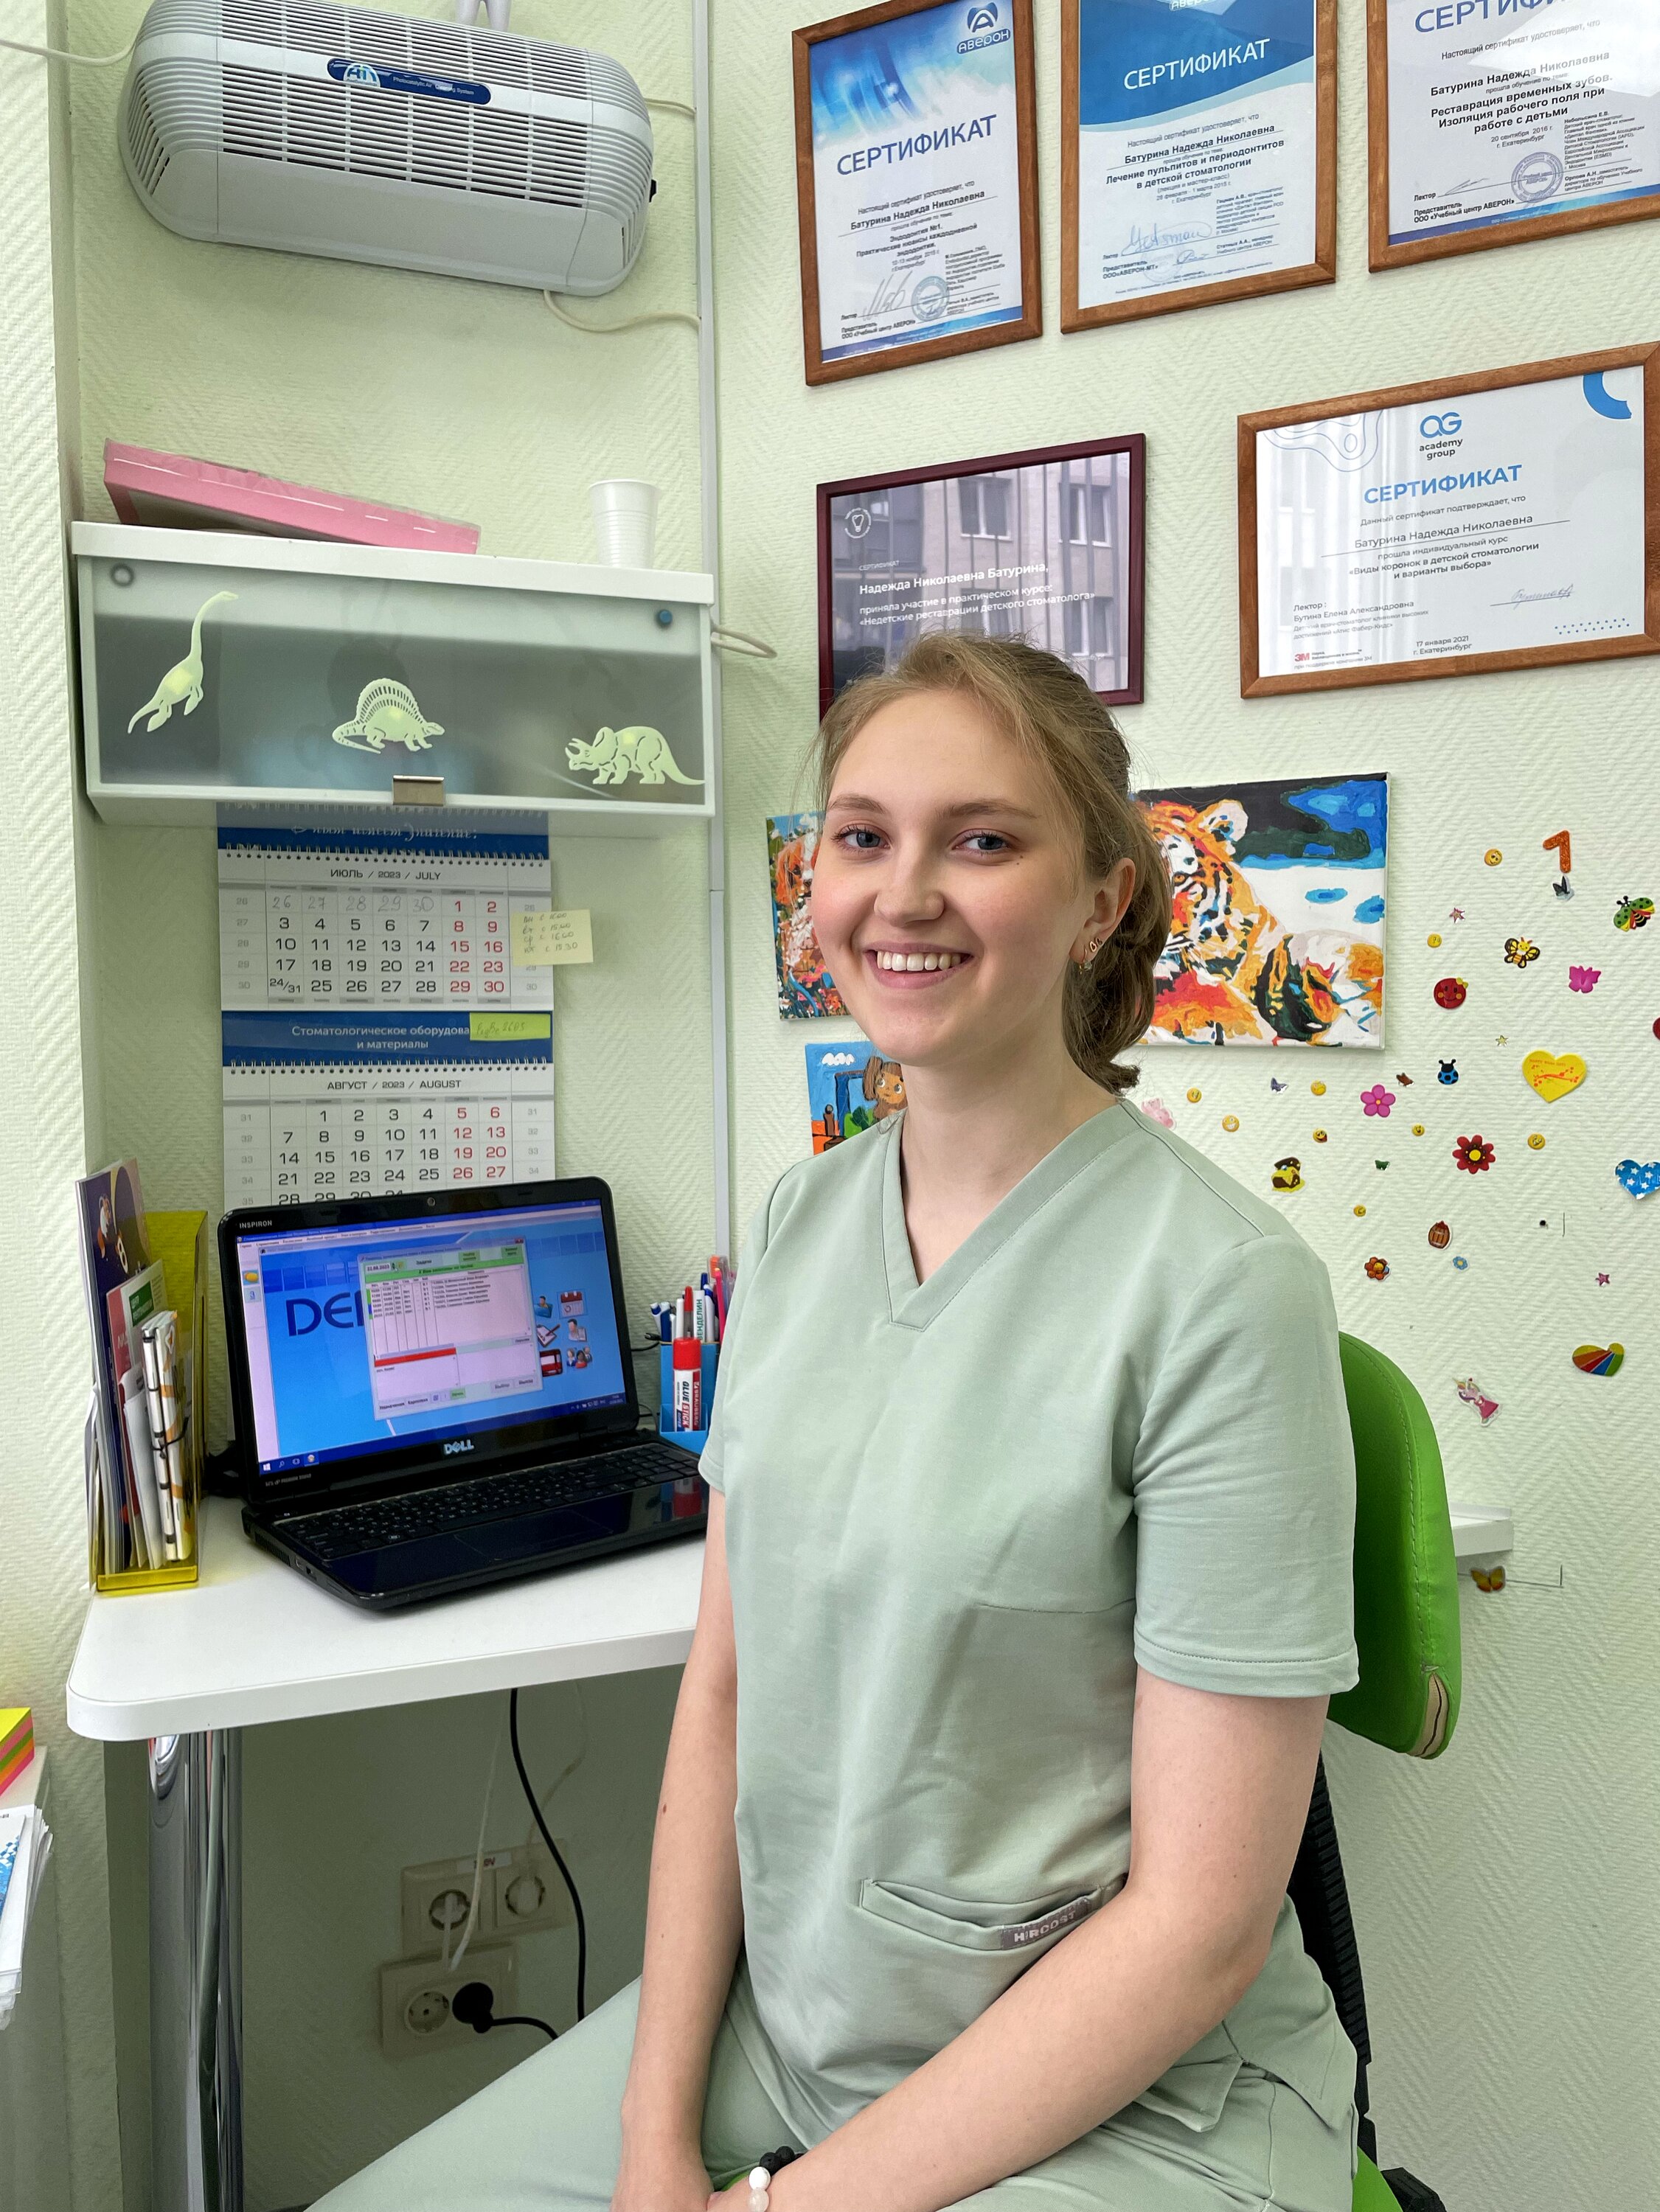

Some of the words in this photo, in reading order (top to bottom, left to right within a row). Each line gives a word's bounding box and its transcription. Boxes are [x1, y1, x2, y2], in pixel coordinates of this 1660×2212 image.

[1415, 0, 1557, 32] СЕРТИФ
[1442, 44, 1483, 60] Настоящий
[1484, 35, 1529, 51] сертификат
[1123, 38, 1271, 91] СЕРТИФИКАТ
[1431, 78, 1483, 96] Батурина
[1487, 67, 1537, 85] Надежда
[1540, 52, 1610, 73] Николаевна
[1431, 97, 1503, 117] Реставрация
[1506, 82, 1572, 102] временных
[1574, 73, 1613, 91] зубов.
[1439, 111, 1493, 128] Изоляция
[1496, 98, 1548, 118] рабочего
[1551, 92, 1579, 105] поля
[1583, 88, 1605, 102] при
[1474, 117, 1513, 134] работе
[1525, 107, 1569, 124] детьми
[837, 114, 997, 175] СЕРТИФИКАТ
[1125, 148, 1170, 164] Батурина
[1172, 139, 1214, 154] Надежда
[1216, 125, 1275, 145] Николаевна
[1106, 170, 1145, 184] Лечение
[1147, 159, 1198, 176] пульпитов
[1209, 140, 1285, 163] периодонтитов
[1145, 173, 1182, 189] детской
[1185, 159, 1251, 178] стоматологии
[1414, 192, 1436, 201] Лектор
[851, 215, 891, 230] Батурина
[894, 204, 930, 220] Надежда
[932, 191, 984, 209] Николаевна
[1414, 201, 1462, 216] Представитель
[1414, 215, 1428, 223] ООО
[1463, 205, 1482, 215] центр
[1419, 438, 1463, 451] academy
[1426, 448, 1456, 460] group
[1364, 464, 1522, 504] СЕРТИФИКАТ
[1395, 508, 1445, 521] сертификат
[1446, 498, 1510, 512] подтверждает,
[1511, 495, 1526, 503] что
[1355, 534, 1406, 549] Батурина
[1409, 526, 1460, 540] Надежда
[1462, 515, 1533, 533] Николаевна
[1378, 550, 1411, 560] прошла
[1413, 539, 1486, 555] индивидуальный
[1488, 536, 1508, 546] курс
[1350, 564, 1379, 576] «Виды
[1381, 559, 1421, 571] коронок
[1430, 552, 1469, 565] детской
[1471, 542, 1539, 559] стоматологии
[1402, 566, 1448, 578] варианты
[1451, 559, 1491, 571] выбора»
[859, 580, 911, 595] Надежда
[913, 571, 984, 589] Николаевна
[987, 563, 1049, 579] Батурина,
[859, 603, 900, 615] приняла
[900, 598, 939, 611] участие
[948, 588, 1019, 605] практическом
[1021, 584, 1053, 597] курсе:
[1293, 602, 1323, 612] Лектор
[859, 613, 914, 626] «Недетские
[915, 605, 979, 621] реставрации
[981, 599, 1024, 613] детского
[1027, 592, 1095, 607] стоматолога»
[1293, 612, 1322, 622] Бутина
[1324, 609, 1348, 619] Елена
[1350, 601, 1414, 615] Александровна
[1420, 643, 1472, 655] Екатеринбург
[1425, 637, 1451, 647] января
[1453, 635, 1469, 643] 2021
[330, 869, 363, 878] ИЮЛЬ
[415, 872, 441, 880] JULY
[272, 895, 291, 909] 26
[308, 896, 325, 910] 27
[346, 896, 367, 911] 28
[378, 895, 401, 912] 29
[413, 896, 434, 912] 30
[487, 901, 497, 913] 2
[279, 917, 290, 929] 3
[315, 918, 325, 930] 4
[351, 919, 361, 931] 5
[386, 919, 395, 931] 6
[420, 920, 429, 931] 7
[454, 920, 464, 932] 8
[488, 921, 497, 933] 9
[275, 938, 296, 950] 10
[311, 939, 329, 950] 11
[347, 939, 366, 951] 12
[382, 940, 401, 951] 13
[417, 940, 436, 952] 14
[451, 941, 470, 952] 15
[484, 941, 503, 953] 16
[277, 959, 296, 971] 17
[312, 959, 331, 971] 18
[347, 960, 367, 971] 19
[381, 960, 402, 972] 20
[415, 961, 434, 972] 21
[450, 961, 470, 973] 22
[483, 961, 503, 973] 23
[311, 980, 332, 992] 25
[347, 980, 367, 992] 26
[381, 981, 401, 992] 27
[416, 981, 436, 992] 28
[450, 981, 470, 992] 29
[484, 981, 504, 992] 30
[292, 1025, 408, 1037] Стоматологическое
[410, 1025, 470, 1038] оборудова
[367, 1040, 428, 1051] материалы
[327, 1081, 368, 1091] АВГУСТ
[420, 1079, 462, 1089] AUGUST
[354, 1110, 364, 1121] 2
[389, 1109, 398, 1121] 3
[423, 1108, 433, 1119] 4
[457, 1107, 467, 1119] 5
[490, 1107, 500, 1119] 6
[283, 1132, 293, 1143] 7
[319, 1131, 329, 1143] 8
[355, 1130, 364, 1141] 9
[385, 1129, 405, 1141] 10
[420, 1128, 436, 1140] 11
[454, 1127, 472, 1139] 12
[487, 1127, 505, 1138] 13
[279, 1152, 299, 1164] 14
[315, 1151, 335, 1164] 15
[350, 1150, 370, 1162] 16
[386, 1150, 404, 1161] 17
[420, 1148, 439, 1160] 18
[454, 1147, 473, 1158] 19
[486, 1147, 507, 1158] 20
[279, 1173, 297, 1185] 21
[314, 1172, 335, 1184] 22
[350, 1171, 370, 1183] 23
[384, 1169, 405, 1181] 24
[419, 1169, 440, 1180] 25
[453, 1167, 473, 1179] 26
[487, 1166, 506, 1178] 27
[279, 1194, 300, 1205] 28
[239, 1220, 273, 1229] INSPIRON
[443, 1439, 474, 1455] DELL
